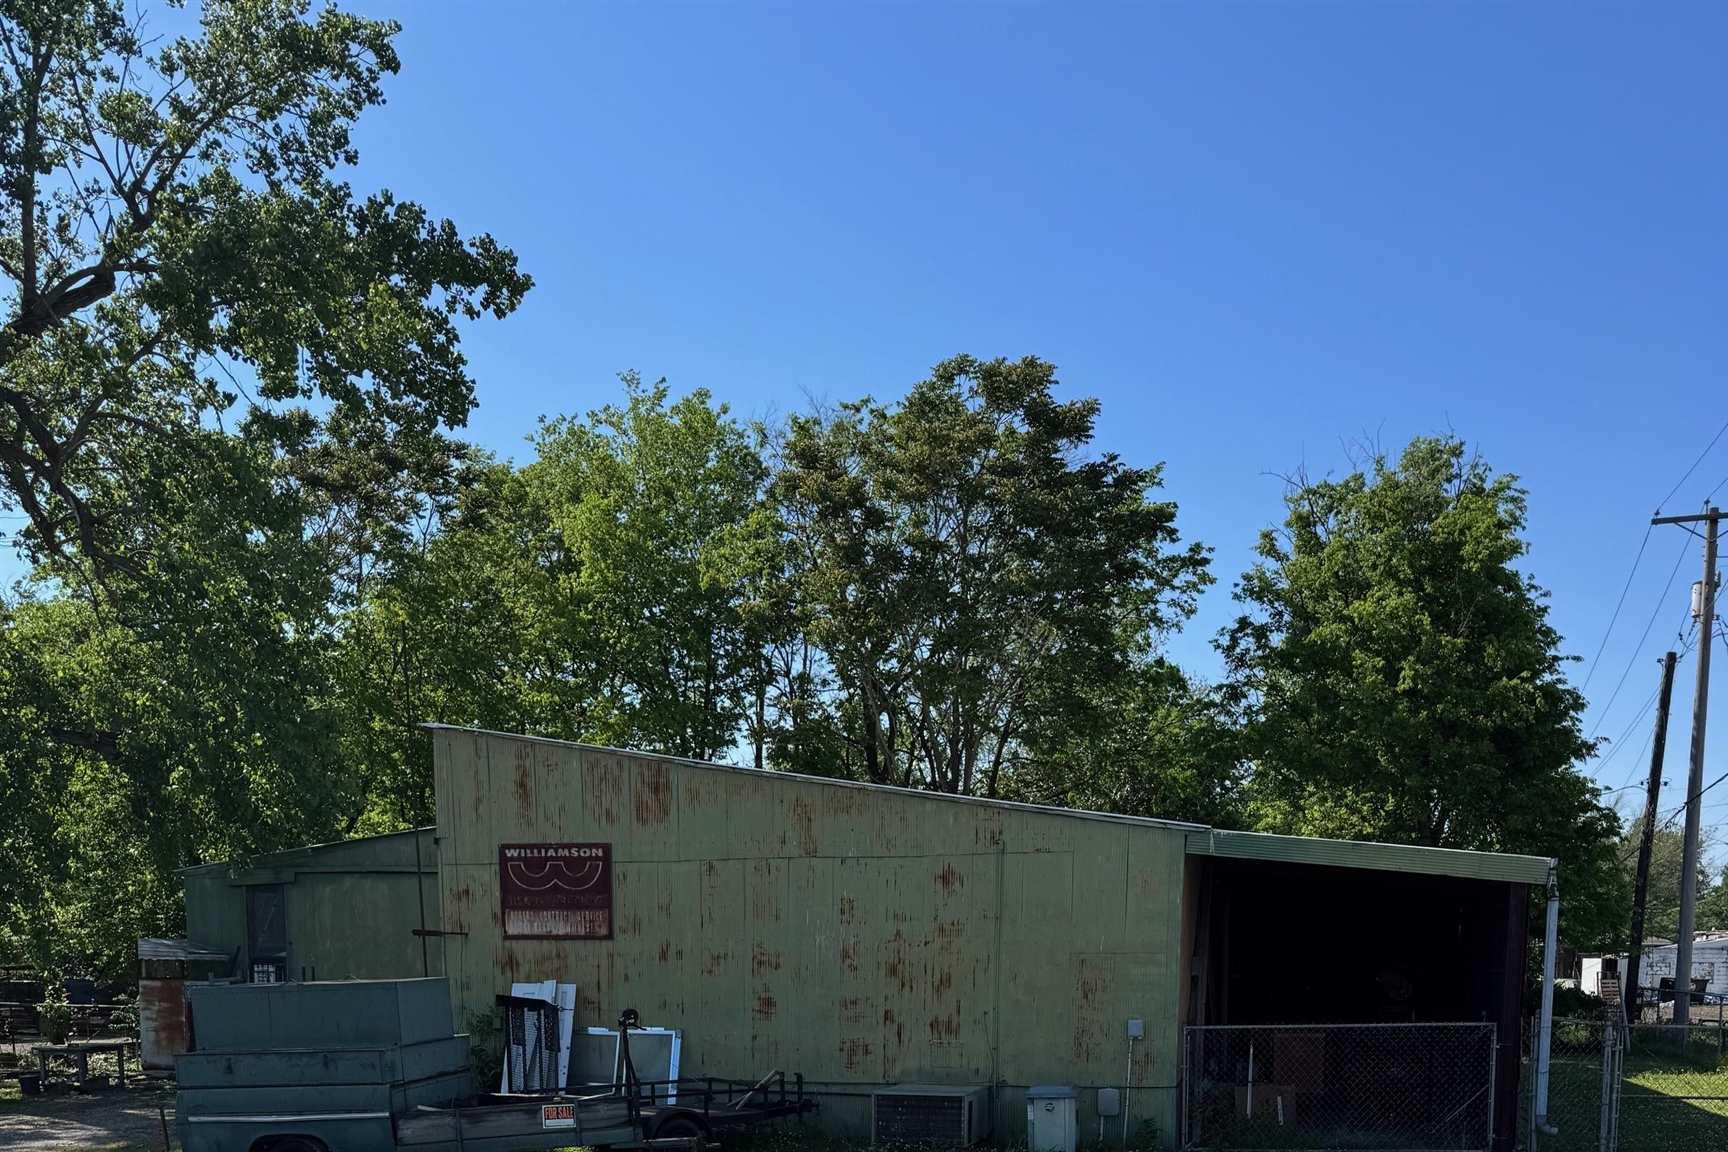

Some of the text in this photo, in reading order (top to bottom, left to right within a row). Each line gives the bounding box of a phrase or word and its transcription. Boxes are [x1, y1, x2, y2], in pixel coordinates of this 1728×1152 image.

[505, 848, 603, 857] WILLIAMSON
[545, 1107, 573, 1119] FOR SALE
